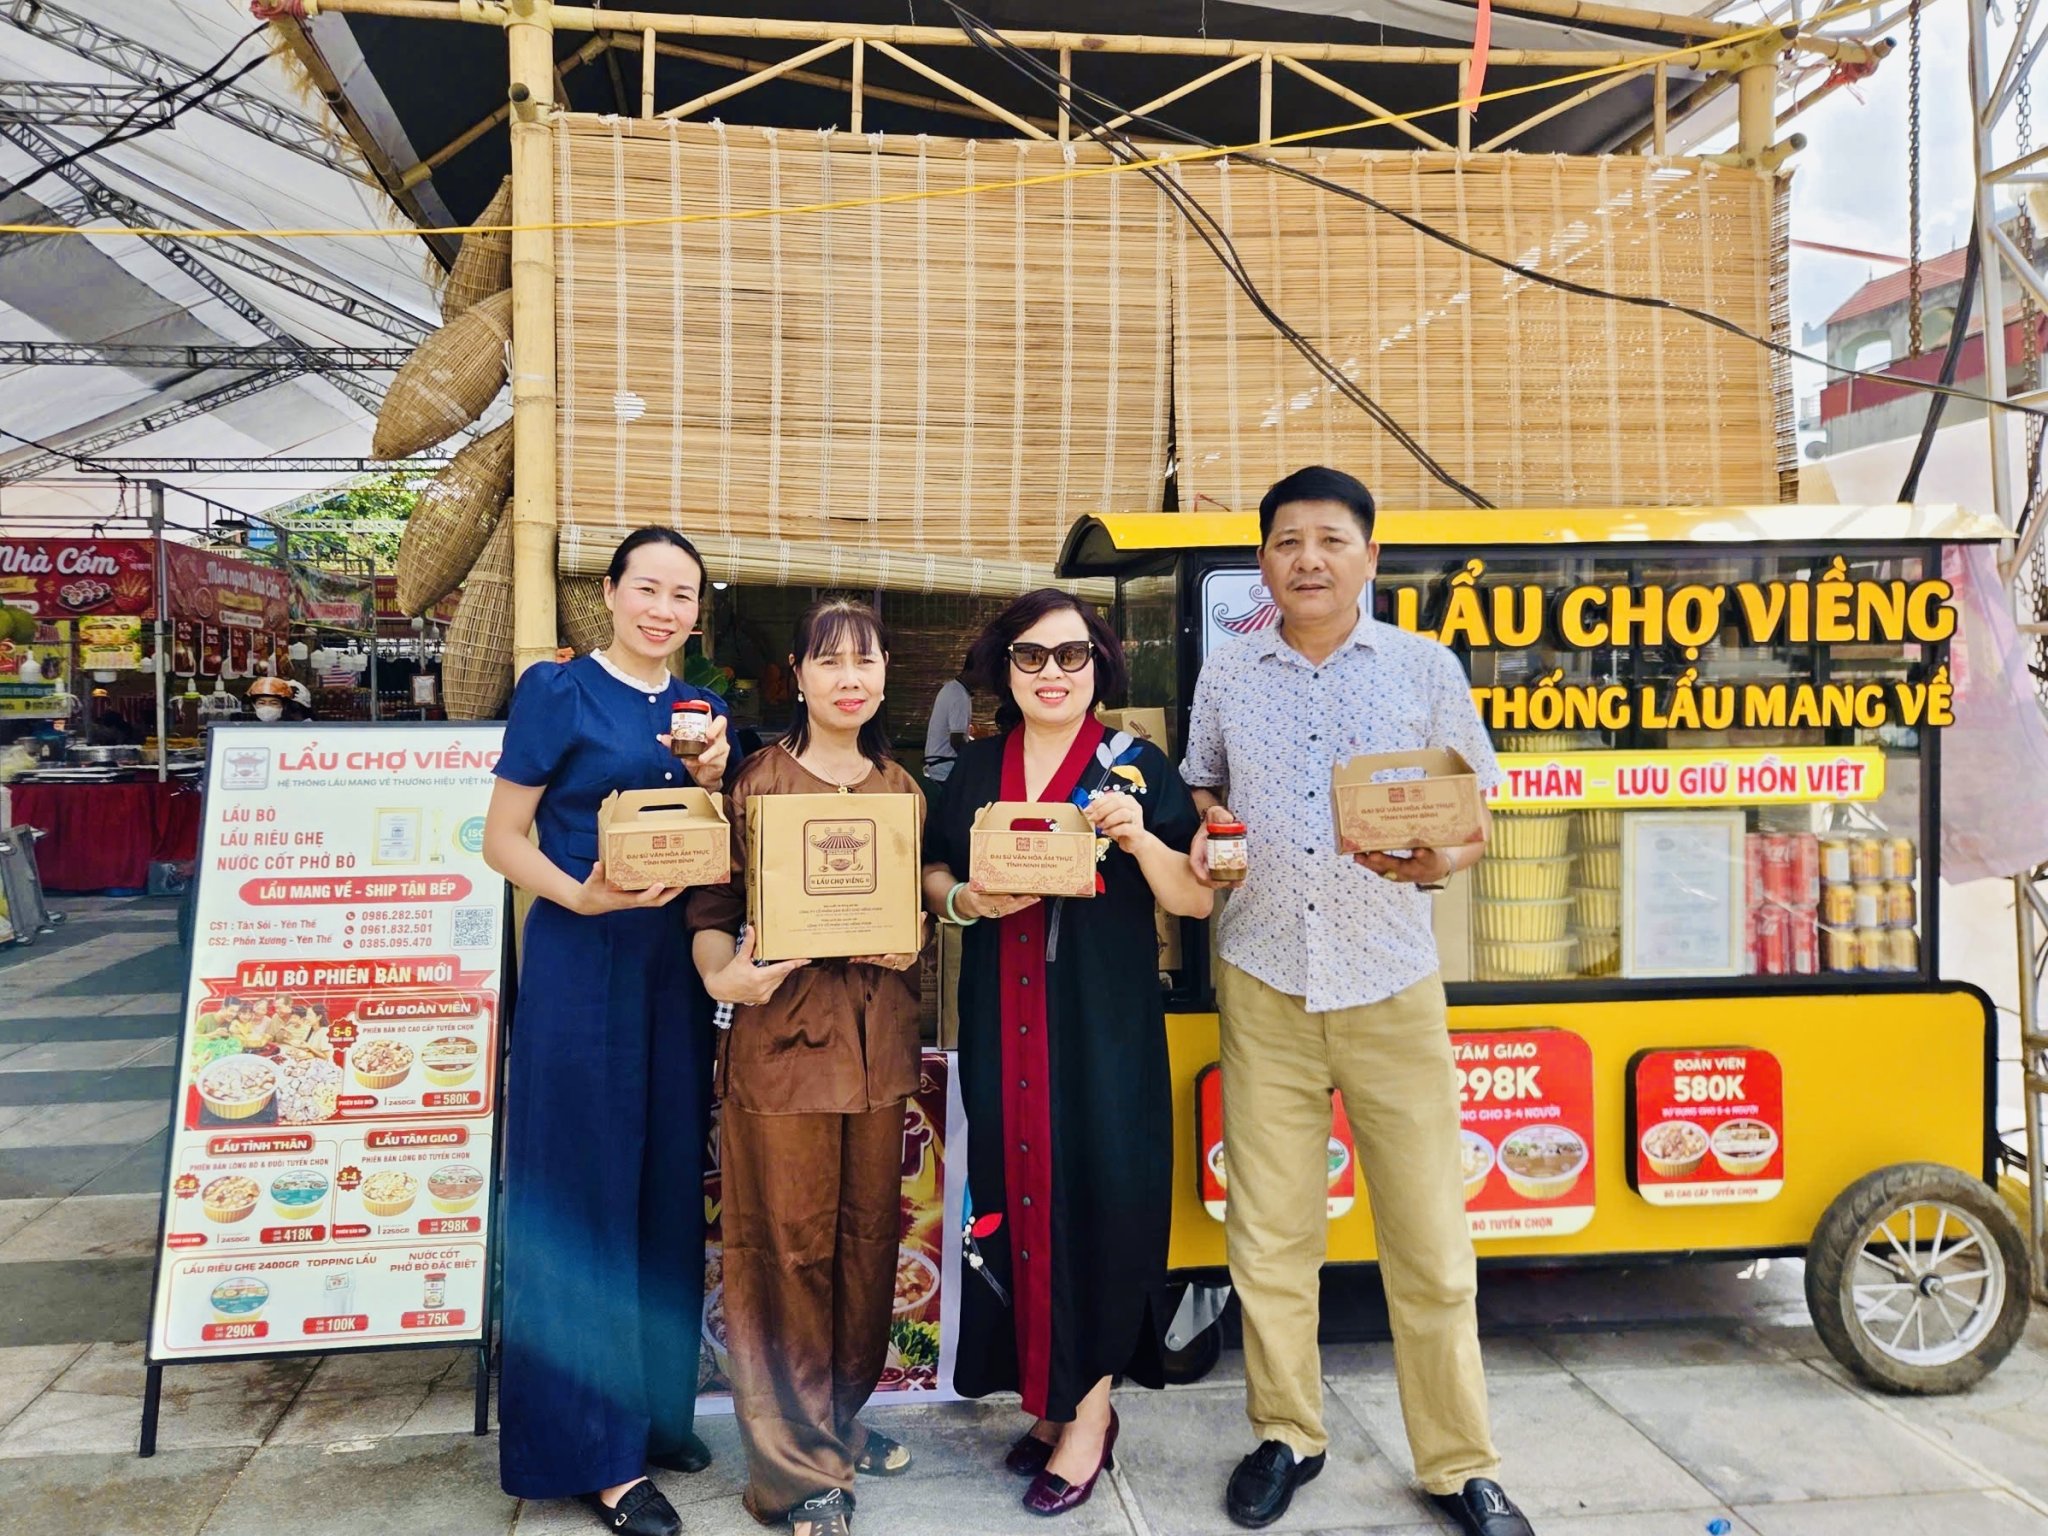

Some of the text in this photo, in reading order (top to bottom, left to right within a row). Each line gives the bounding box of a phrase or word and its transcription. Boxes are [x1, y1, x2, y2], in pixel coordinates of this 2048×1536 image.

[0, 545, 120, 575] Nhà Cốm
[1398, 555, 1958, 661] LẨU CHỢ VIỀNG
[1474, 665, 1954, 730] THỐNG LẨU MANG VỀ
[278, 740, 501, 775] LẨU CHỢ VIỀNG
[349, 777, 376, 787] MANG
[481, 777, 493, 785] NA
[1508, 763, 1583, 798] THÂN
[1618, 764, 1670, 797] LƯU
[1680, 761, 1728, 794] GIỮ
[1738, 756, 1797, 793] HỒN
[1807, 758, 1864, 798] VIỆT
[256, 805, 276, 823] BÒ
[220, 829, 324, 849] LẨU RIÊU GHẸ
[217, 850, 356, 870] NƯỚC CỐT PHỞ BÒ
[260, 877, 456, 900] LẨU MANG VỀ SHIP TẬN BẾP
[362, 910, 433, 921] 0986.282.501
[209, 921, 228, 931] CS1
[360, 924, 432, 935] 0961.832.501
[208, 936, 230, 947] CS2:
[359, 938, 432, 949] 0385.095.470
[242, 961, 452, 988] LẨU BÒ PHIÊN BẢN MỚI
[367, 1001, 471, 1017] LẨU ĐOÀN VIÊN
[333, 1026, 352, 1038] 5-6
[408, 1025, 421, 1033] CAO
[1452, 1042, 1537, 1060] TÂM GIAO
[1674, 1056, 1746, 1073] ĐOÀN VIÊN
[1456, 1066, 1543, 1101] 298K
[1674, 1075, 1745, 1103] 580K
[443, 1092, 470, 1106] 580K
[1479, 1108, 1503, 1121] CHO
[1504, 1108, 1523, 1120] 3-4
[214, 1139, 307, 1153] LẨU TÌNH THÂN
[376, 1132, 457, 1146] LẨU TÂM GIAO
[342, 1172, 357, 1181] 3-4
[441, 1219, 469, 1233] 298K
[284, 1228, 313, 1241] 418K
[440, 1247, 460, 1259] CỐT
[207, 1261, 232, 1273] RIÊU
[234, 1262, 256, 1272] GHẸ
[258, 1260, 299, 1270] 2400GR
[307, 1257, 354, 1268] TOPPING
[415, 1260, 428, 1271] BÒ
[327, 1317, 356, 1331] 100K
[428, 1312, 449, 1326] 75K
[226, 1324, 256, 1339] 290K
